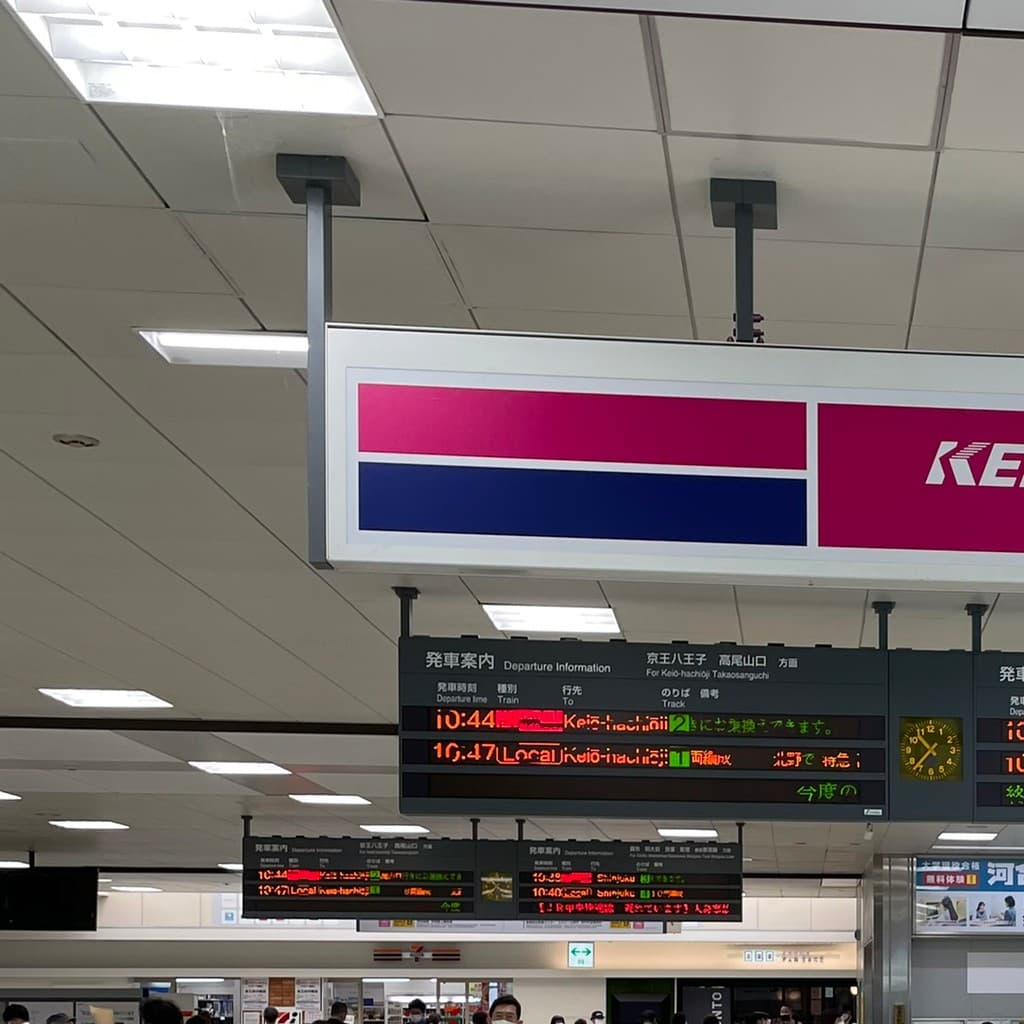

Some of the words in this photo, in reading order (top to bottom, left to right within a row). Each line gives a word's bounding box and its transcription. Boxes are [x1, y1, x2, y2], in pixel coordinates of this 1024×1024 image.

[425, 651, 495, 671] 発車案内
[646, 652, 707, 666] 京王八王子
[719, 654, 767, 667] 高尾山口
[779, 658, 798, 668] 方面
[504, 660, 554, 673] Departure
[556, 661, 611, 673] Information
[646, 669, 660, 677] For
[712, 670, 770, 681] Takaosanguchi
[437, 682, 478, 693] 発車時刻
[497, 684, 517, 694] 種別
[562, 685, 583, 695] 行先
[661, 688, 690, 698] のりば
[497, 696, 519, 705] Train
[562, 697, 574, 706] To
[662, 700, 686, 708] Track
[436, 709, 496, 730] 10:44
[433, 742, 497, 762] 10:47
[503, 745, 556, 762] Local
[797, 783, 857, 802] 今度の
